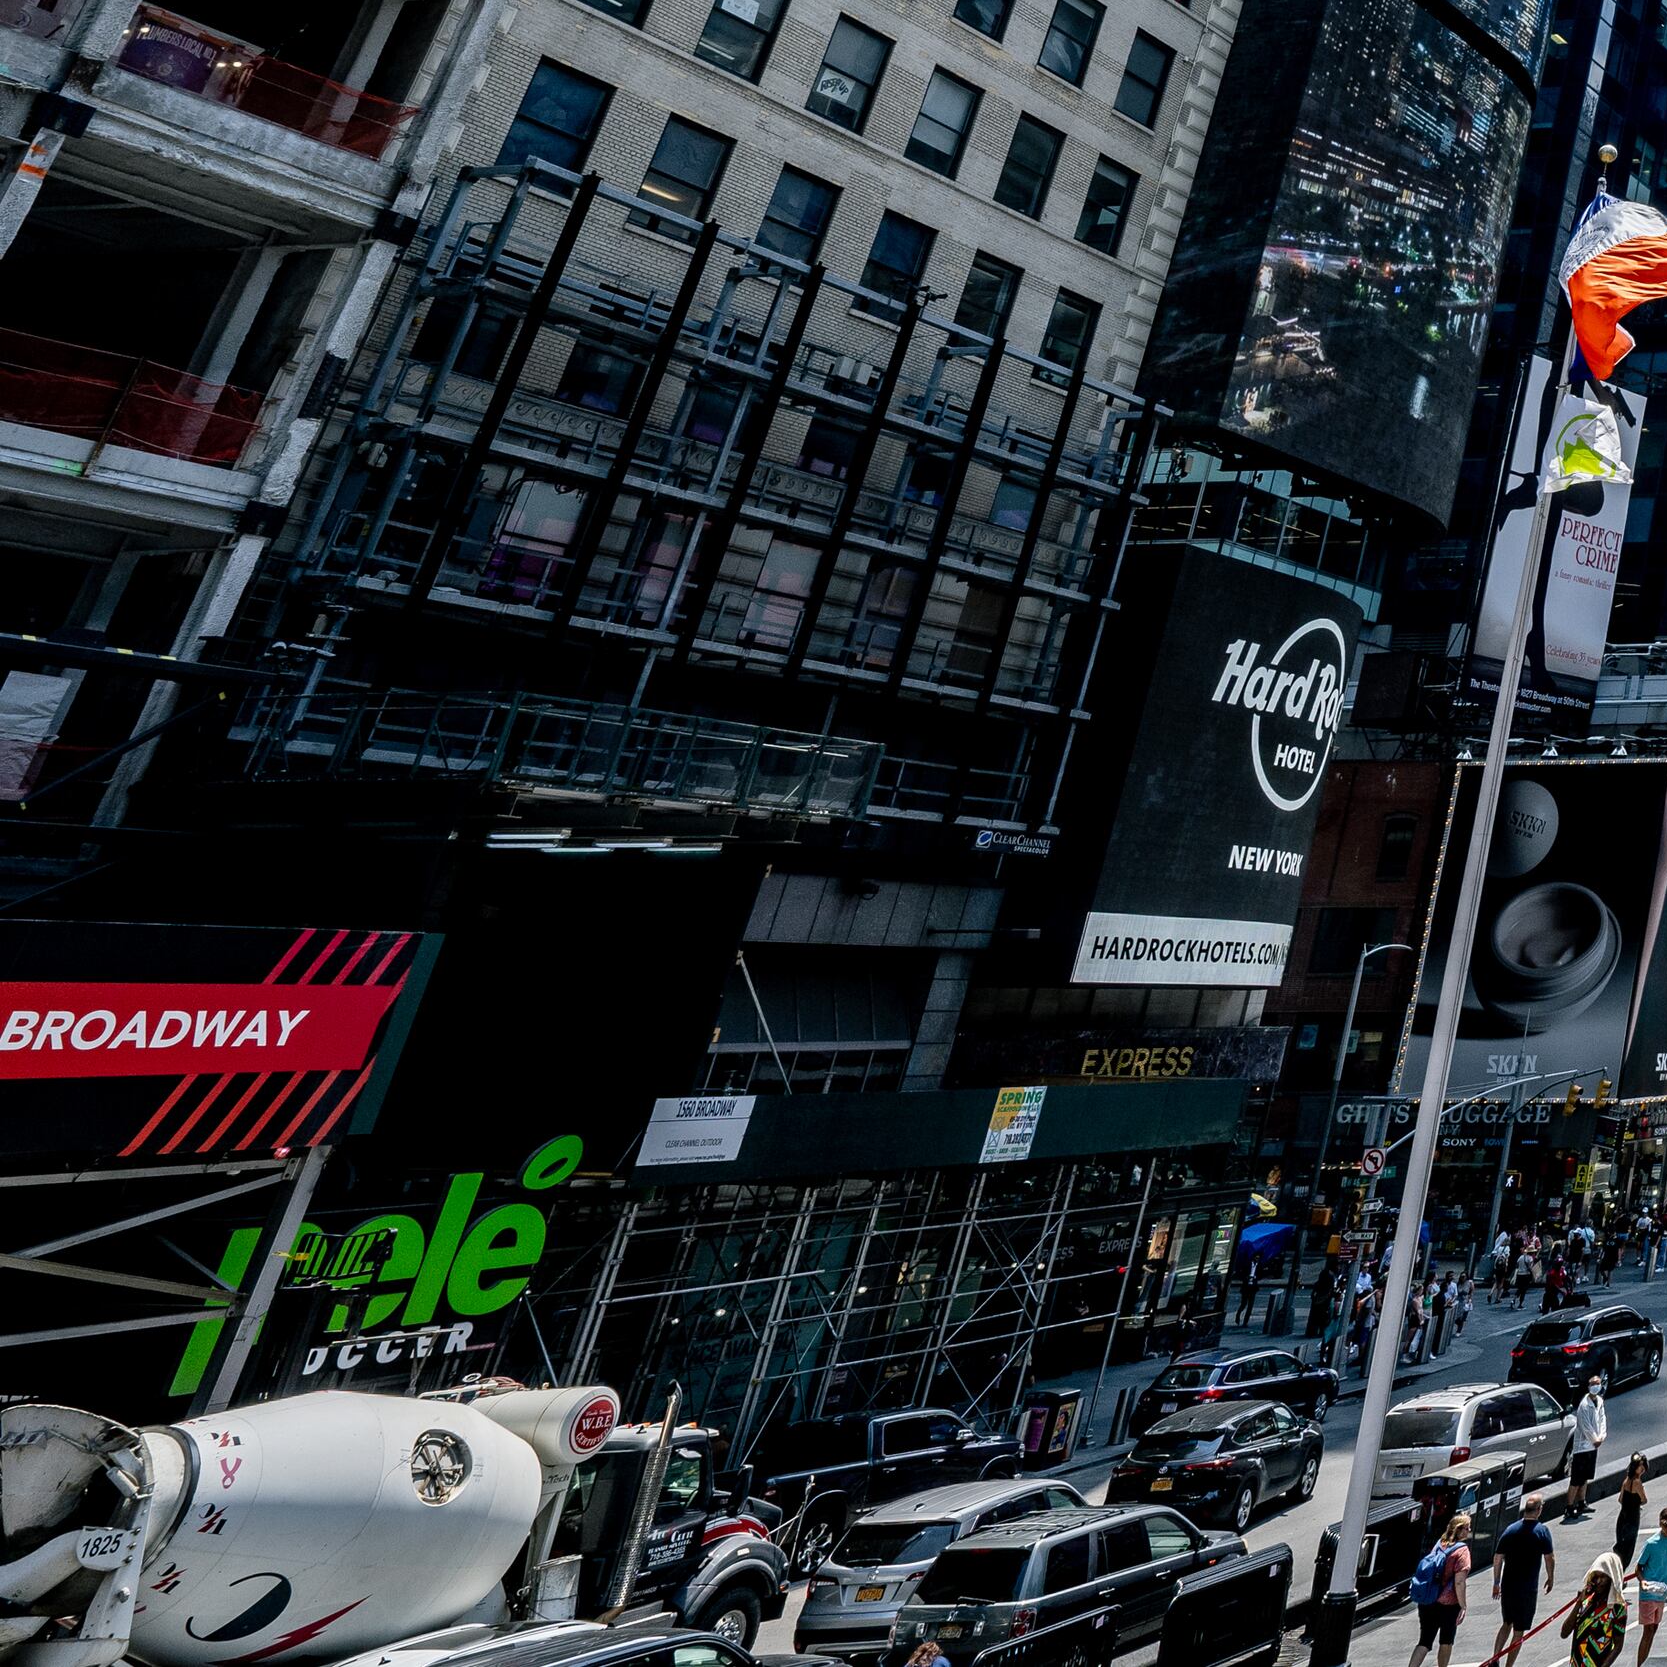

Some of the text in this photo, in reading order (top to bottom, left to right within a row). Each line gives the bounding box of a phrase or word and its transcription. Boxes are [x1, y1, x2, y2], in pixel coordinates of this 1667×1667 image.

[1562, 517, 1622, 552] PERFECT
[1576, 543, 1618, 574] CRIME
[1212, 639, 1320, 718] Hard
[1533, 690, 1590, 710] Broadway Street
[1274, 744, 1316, 774] HOTEL
[1228, 845, 1303, 877] NEW YORK
[0, 1009, 311, 1051] BROADWAY
[1081, 1047, 1194, 1076] EXPRESS
[676, 1100, 738, 1118] 1560 BROADWAY
[1000, 1091, 1042, 1105] SPRING
[700, 1138, 723, 1147] OUTDOOR
[1442, 1138, 1476, 1147] SONY
[81, 1535, 121, 1559] 1825
